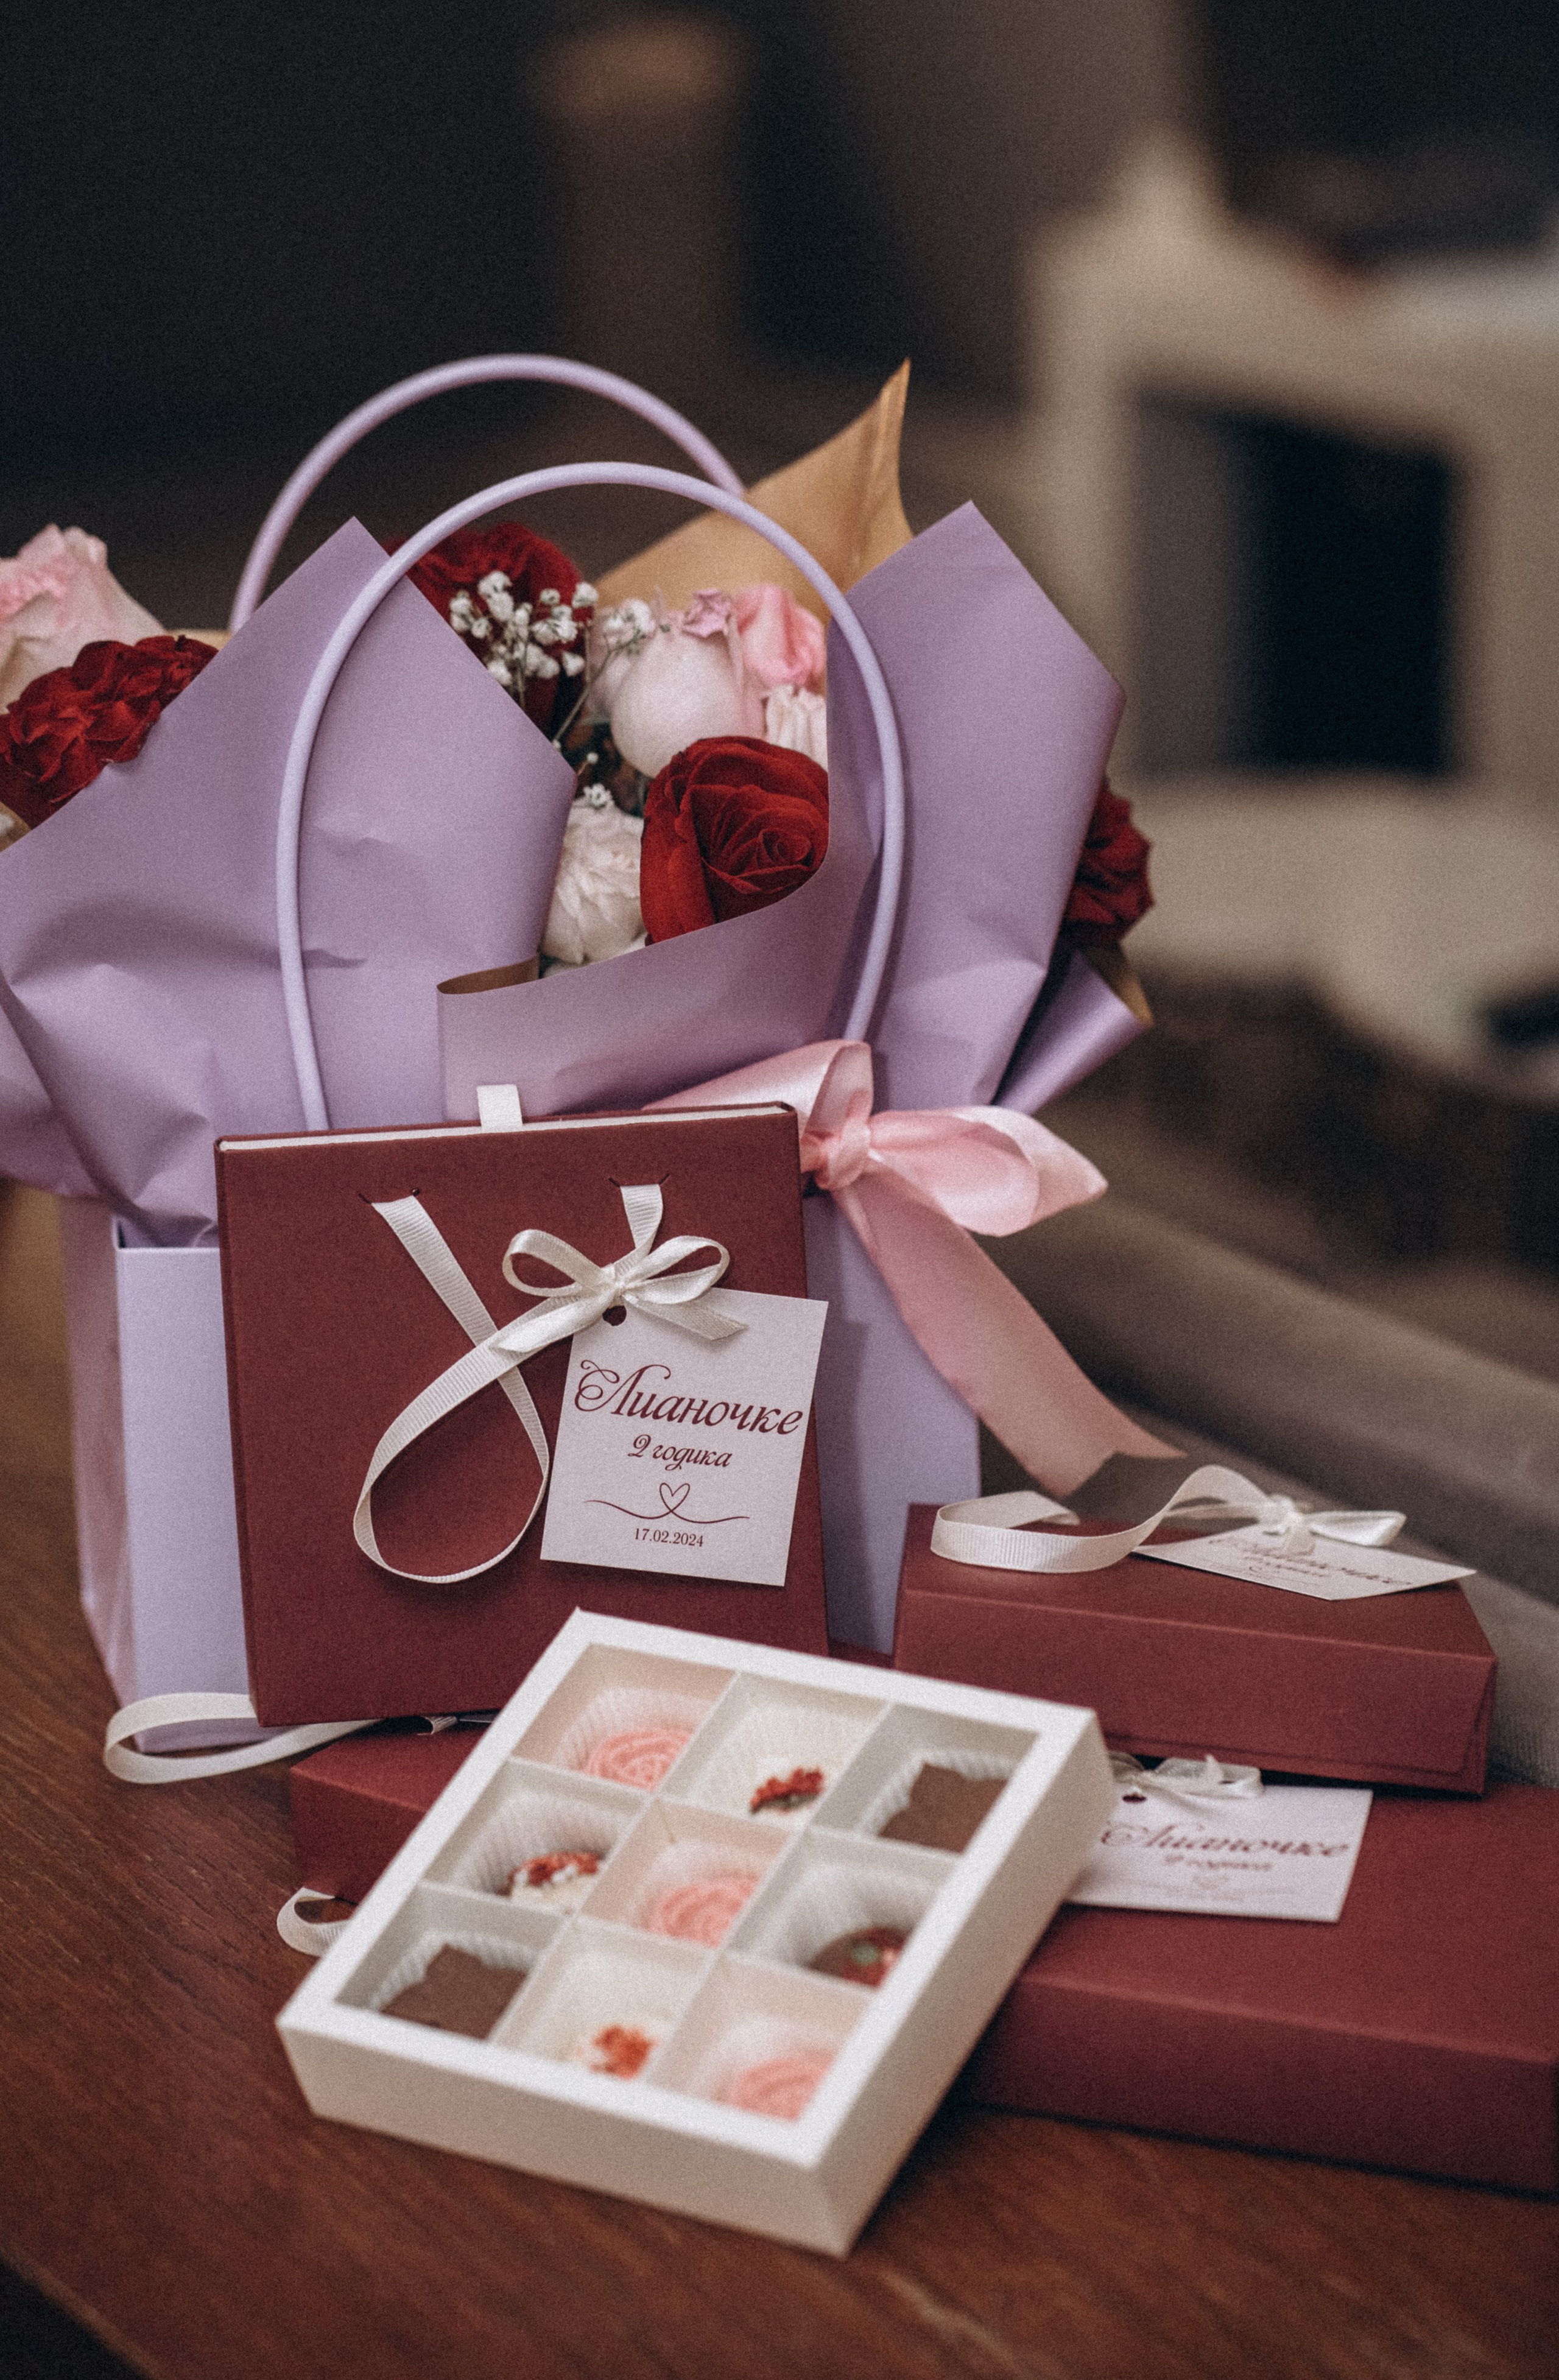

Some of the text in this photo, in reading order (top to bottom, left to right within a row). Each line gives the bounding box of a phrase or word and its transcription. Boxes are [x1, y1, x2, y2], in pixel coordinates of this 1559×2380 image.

[574, 1360, 803, 1435] Лианочке
[628, 1434, 733, 1471] 2 годика
[634, 1527, 704, 1547] 17.02.2024
